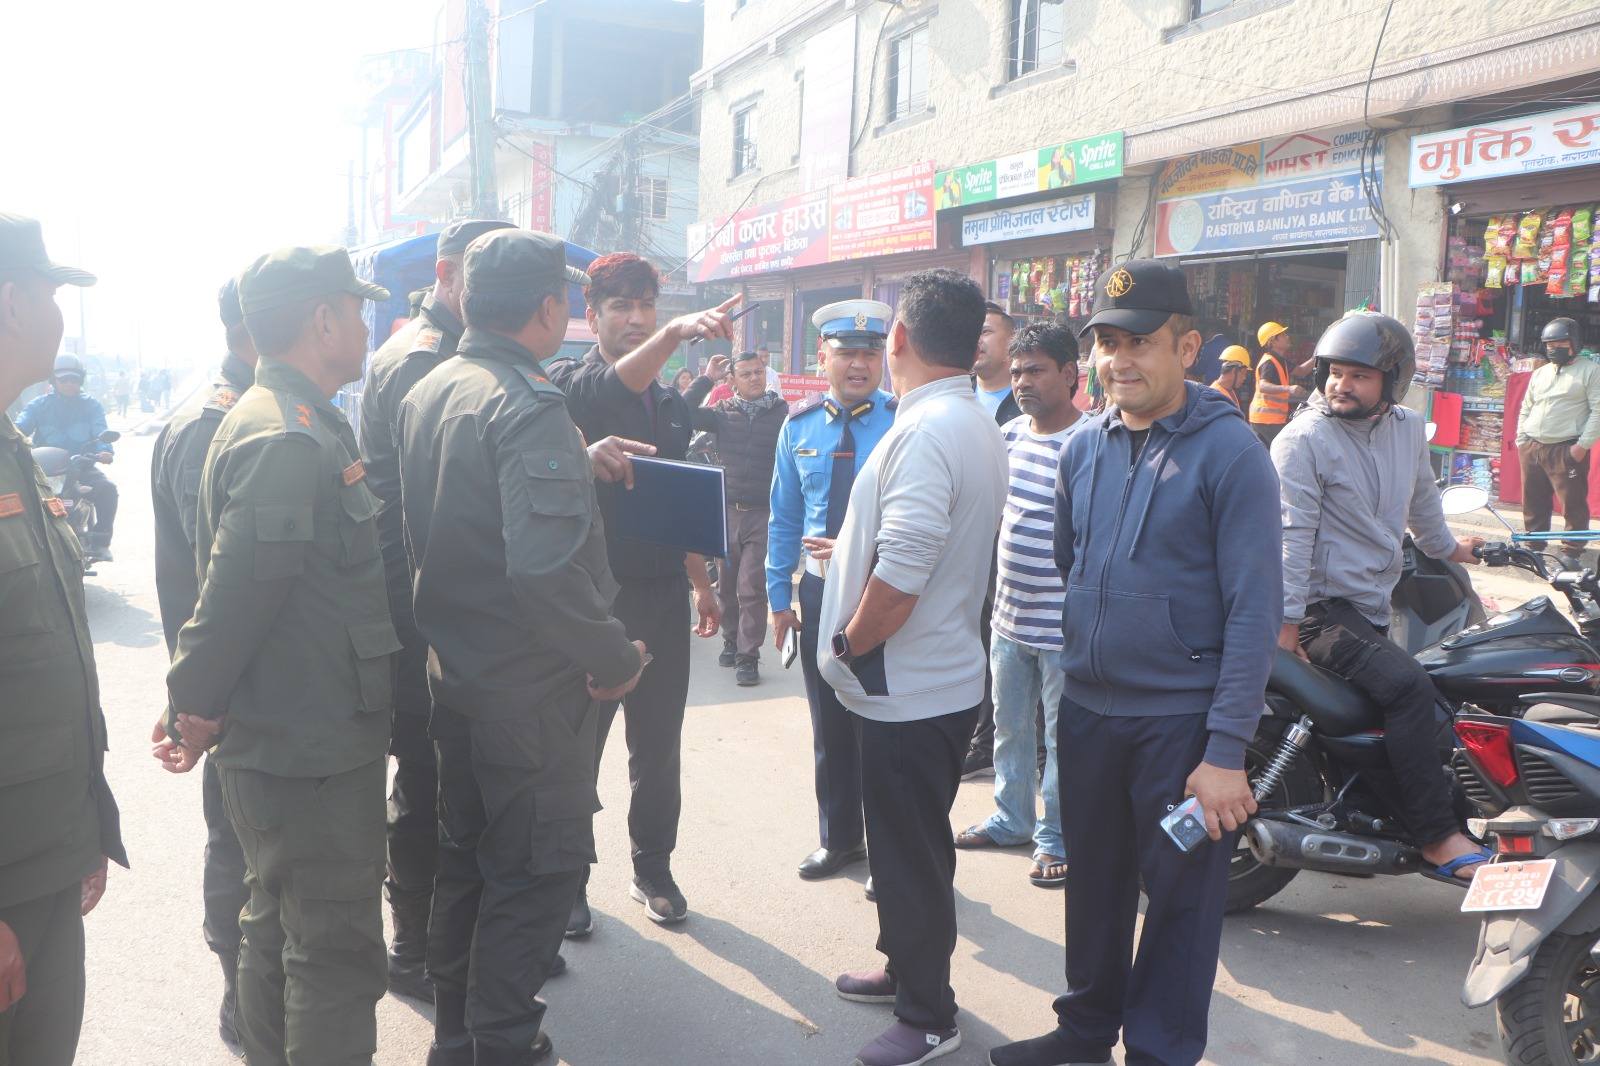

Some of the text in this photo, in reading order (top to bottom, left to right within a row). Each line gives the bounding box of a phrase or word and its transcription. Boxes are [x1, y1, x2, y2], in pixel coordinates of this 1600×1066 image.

[1080, 140, 1116, 168] Sprite
[1417, 126, 1533, 180] मुक्ति
[965, 170, 992, 193] Sprite
[1262, 188, 1325, 212] वाणिज्य
[1327, 180, 1355, 204] बैंक
[739, 212, 779, 243] कलर
[782, 200, 827, 237] हाउस
[1206, 220, 1254, 239] RASTRIYA
[1256, 214, 1306, 233] BANIJYA
[1308, 208, 1345, 227] BANK
